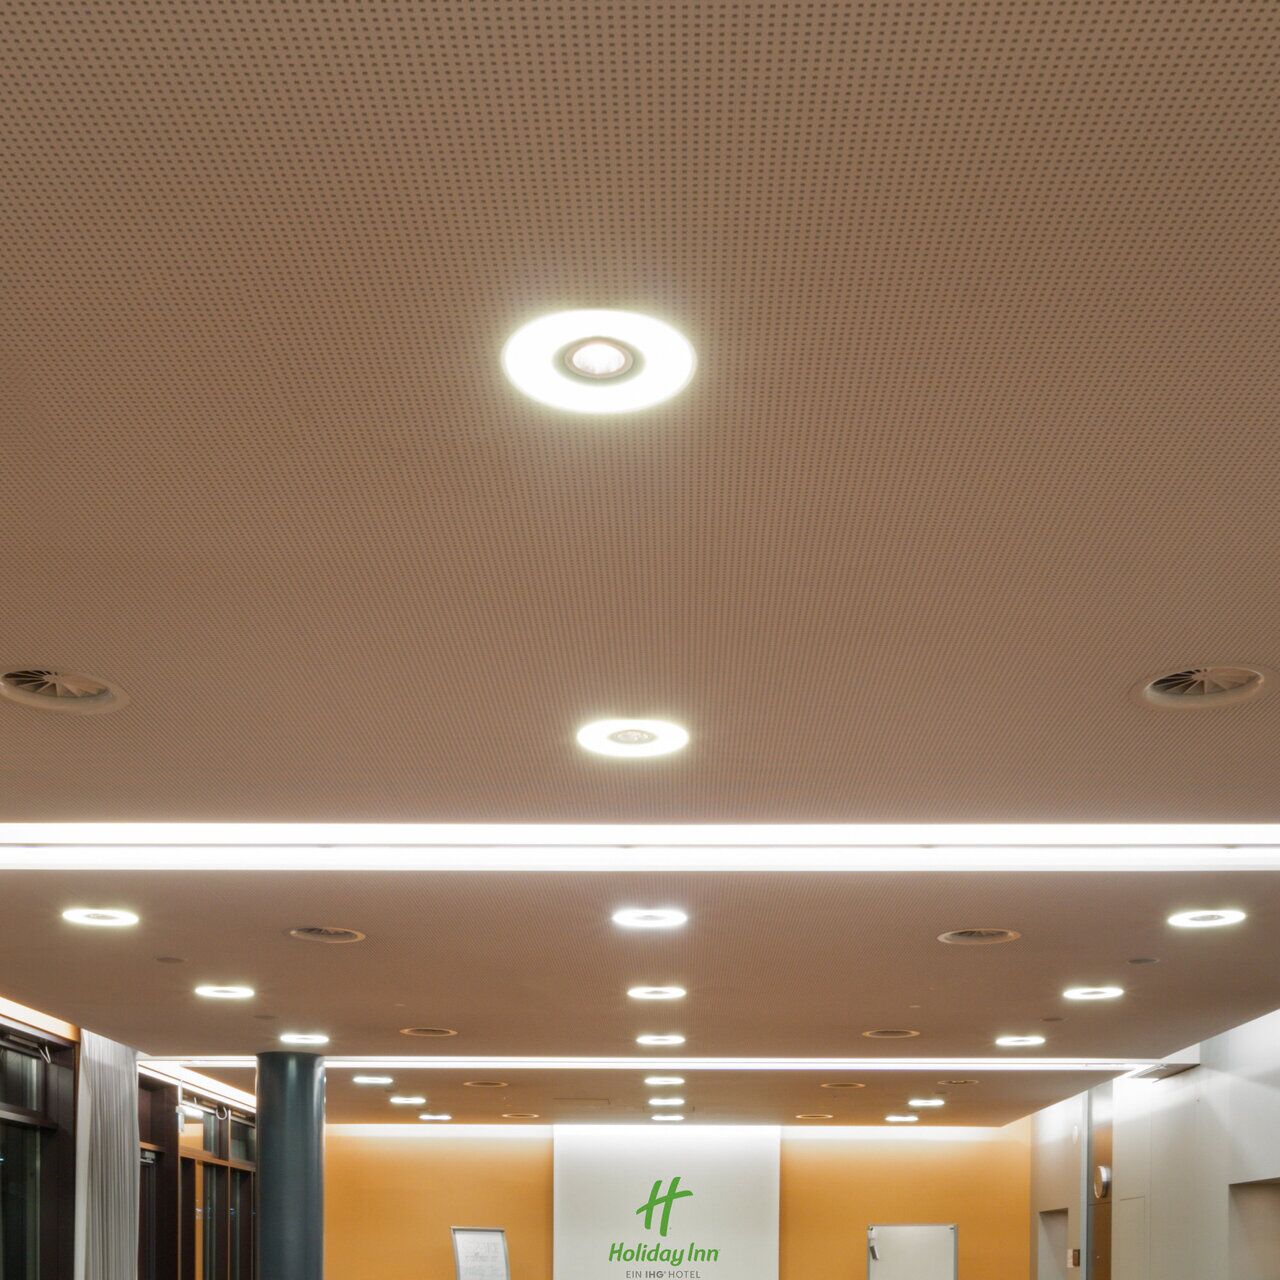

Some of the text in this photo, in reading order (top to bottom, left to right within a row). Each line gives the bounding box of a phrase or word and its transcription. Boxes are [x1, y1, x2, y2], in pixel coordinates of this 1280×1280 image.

[608, 1242, 719, 1266] Holiday Inn
[625, 1270, 642, 1279] EIN
[668, 1270, 701, 1279] HOTEL
